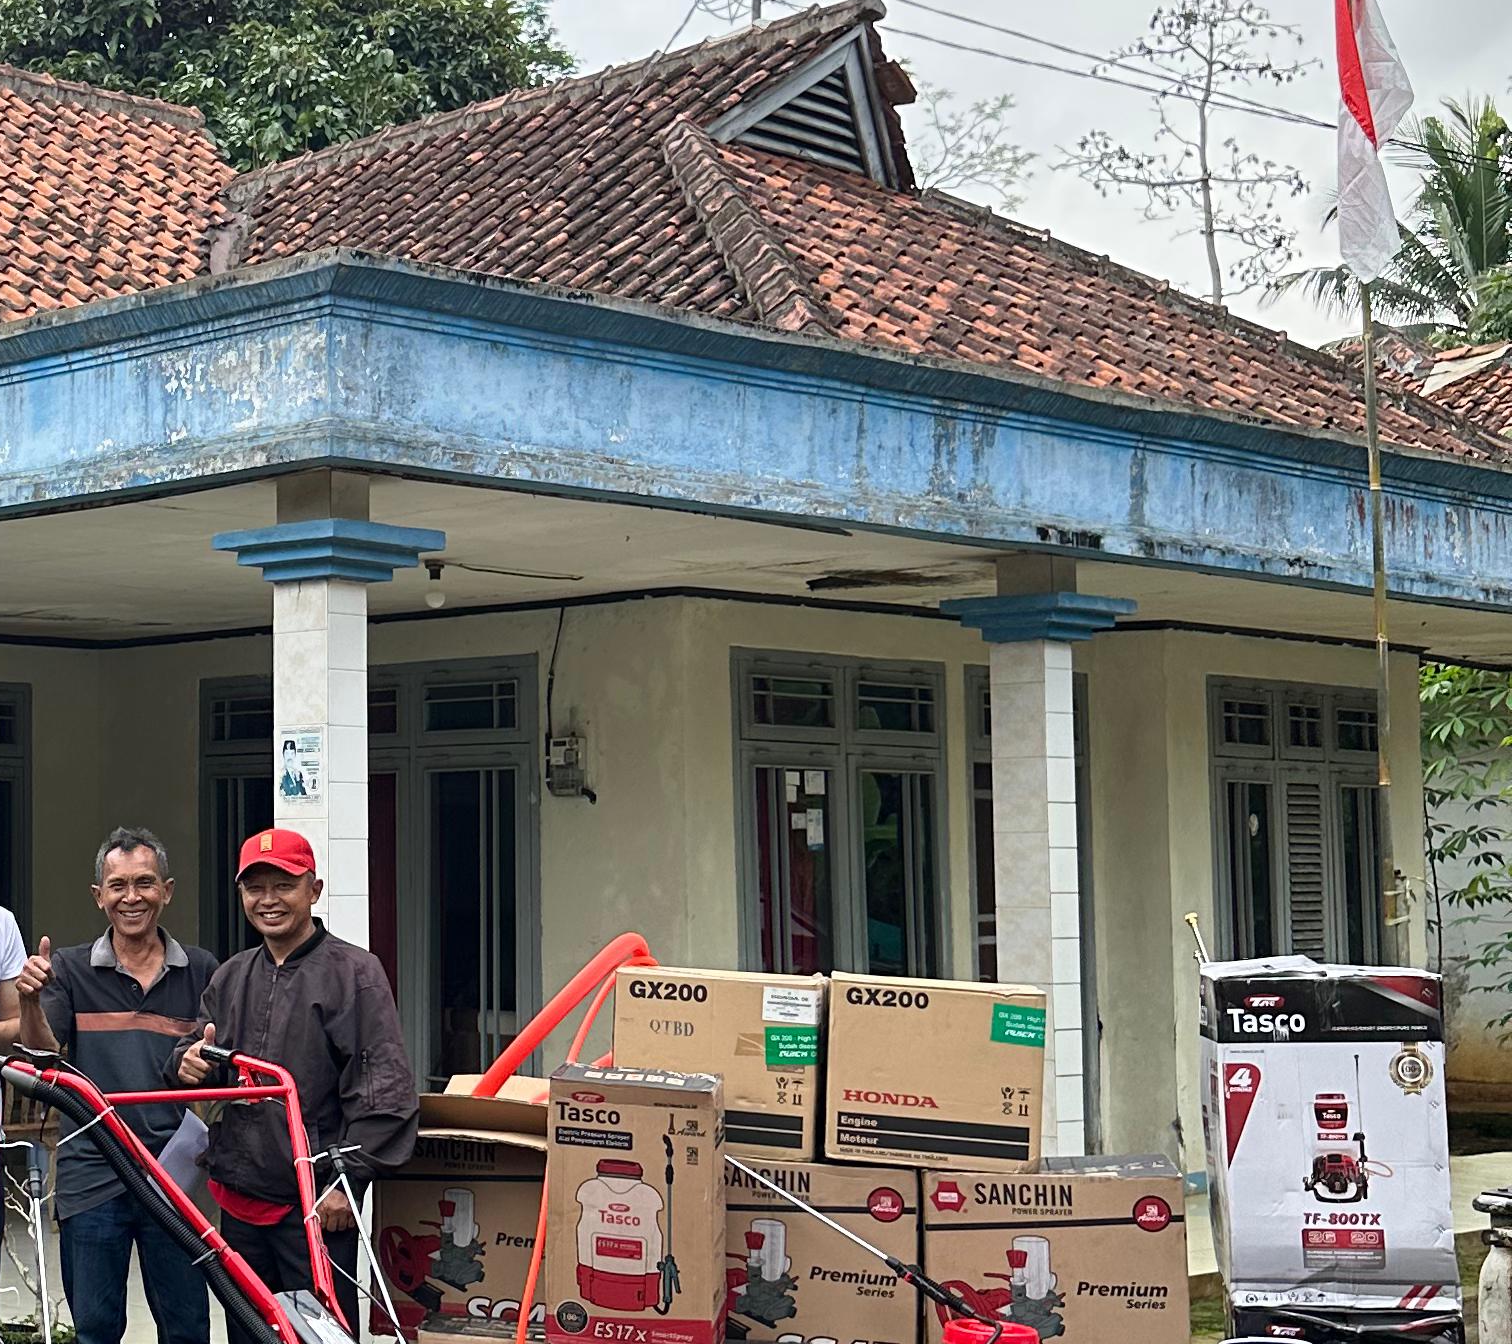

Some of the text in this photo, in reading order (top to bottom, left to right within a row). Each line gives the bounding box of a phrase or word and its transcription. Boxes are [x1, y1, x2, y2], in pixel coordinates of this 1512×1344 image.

[629, 980, 707, 1002] GX200
[846, 987, 929, 1009] GX200
[649, 1018, 695, 1037] QTBD
[1227, 1008, 1306, 1033] Tasco
[1229, 1067, 1253, 1086] 4
[843, 1089, 938, 1108] HONDA
[555, 1101, 621, 1125] Tasco
[840, 1114, 879, 1128] Engine
[839, 1132, 879, 1146] Moteur
[974, 1182, 1073, 1207] SANCHIN
[598, 1209, 641, 1227] Tasco
[1012, 1207, 1073, 1217] POWER SPRAYER
[1303, 1212, 1382, 1226] TF-800TX
[809, 1266, 898, 1287] Premium
[856, 1286, 895, 1299] Series
[1077, 1281, 1169, 1298] Premium
[1126, 1298, 1167, 1310] Series
